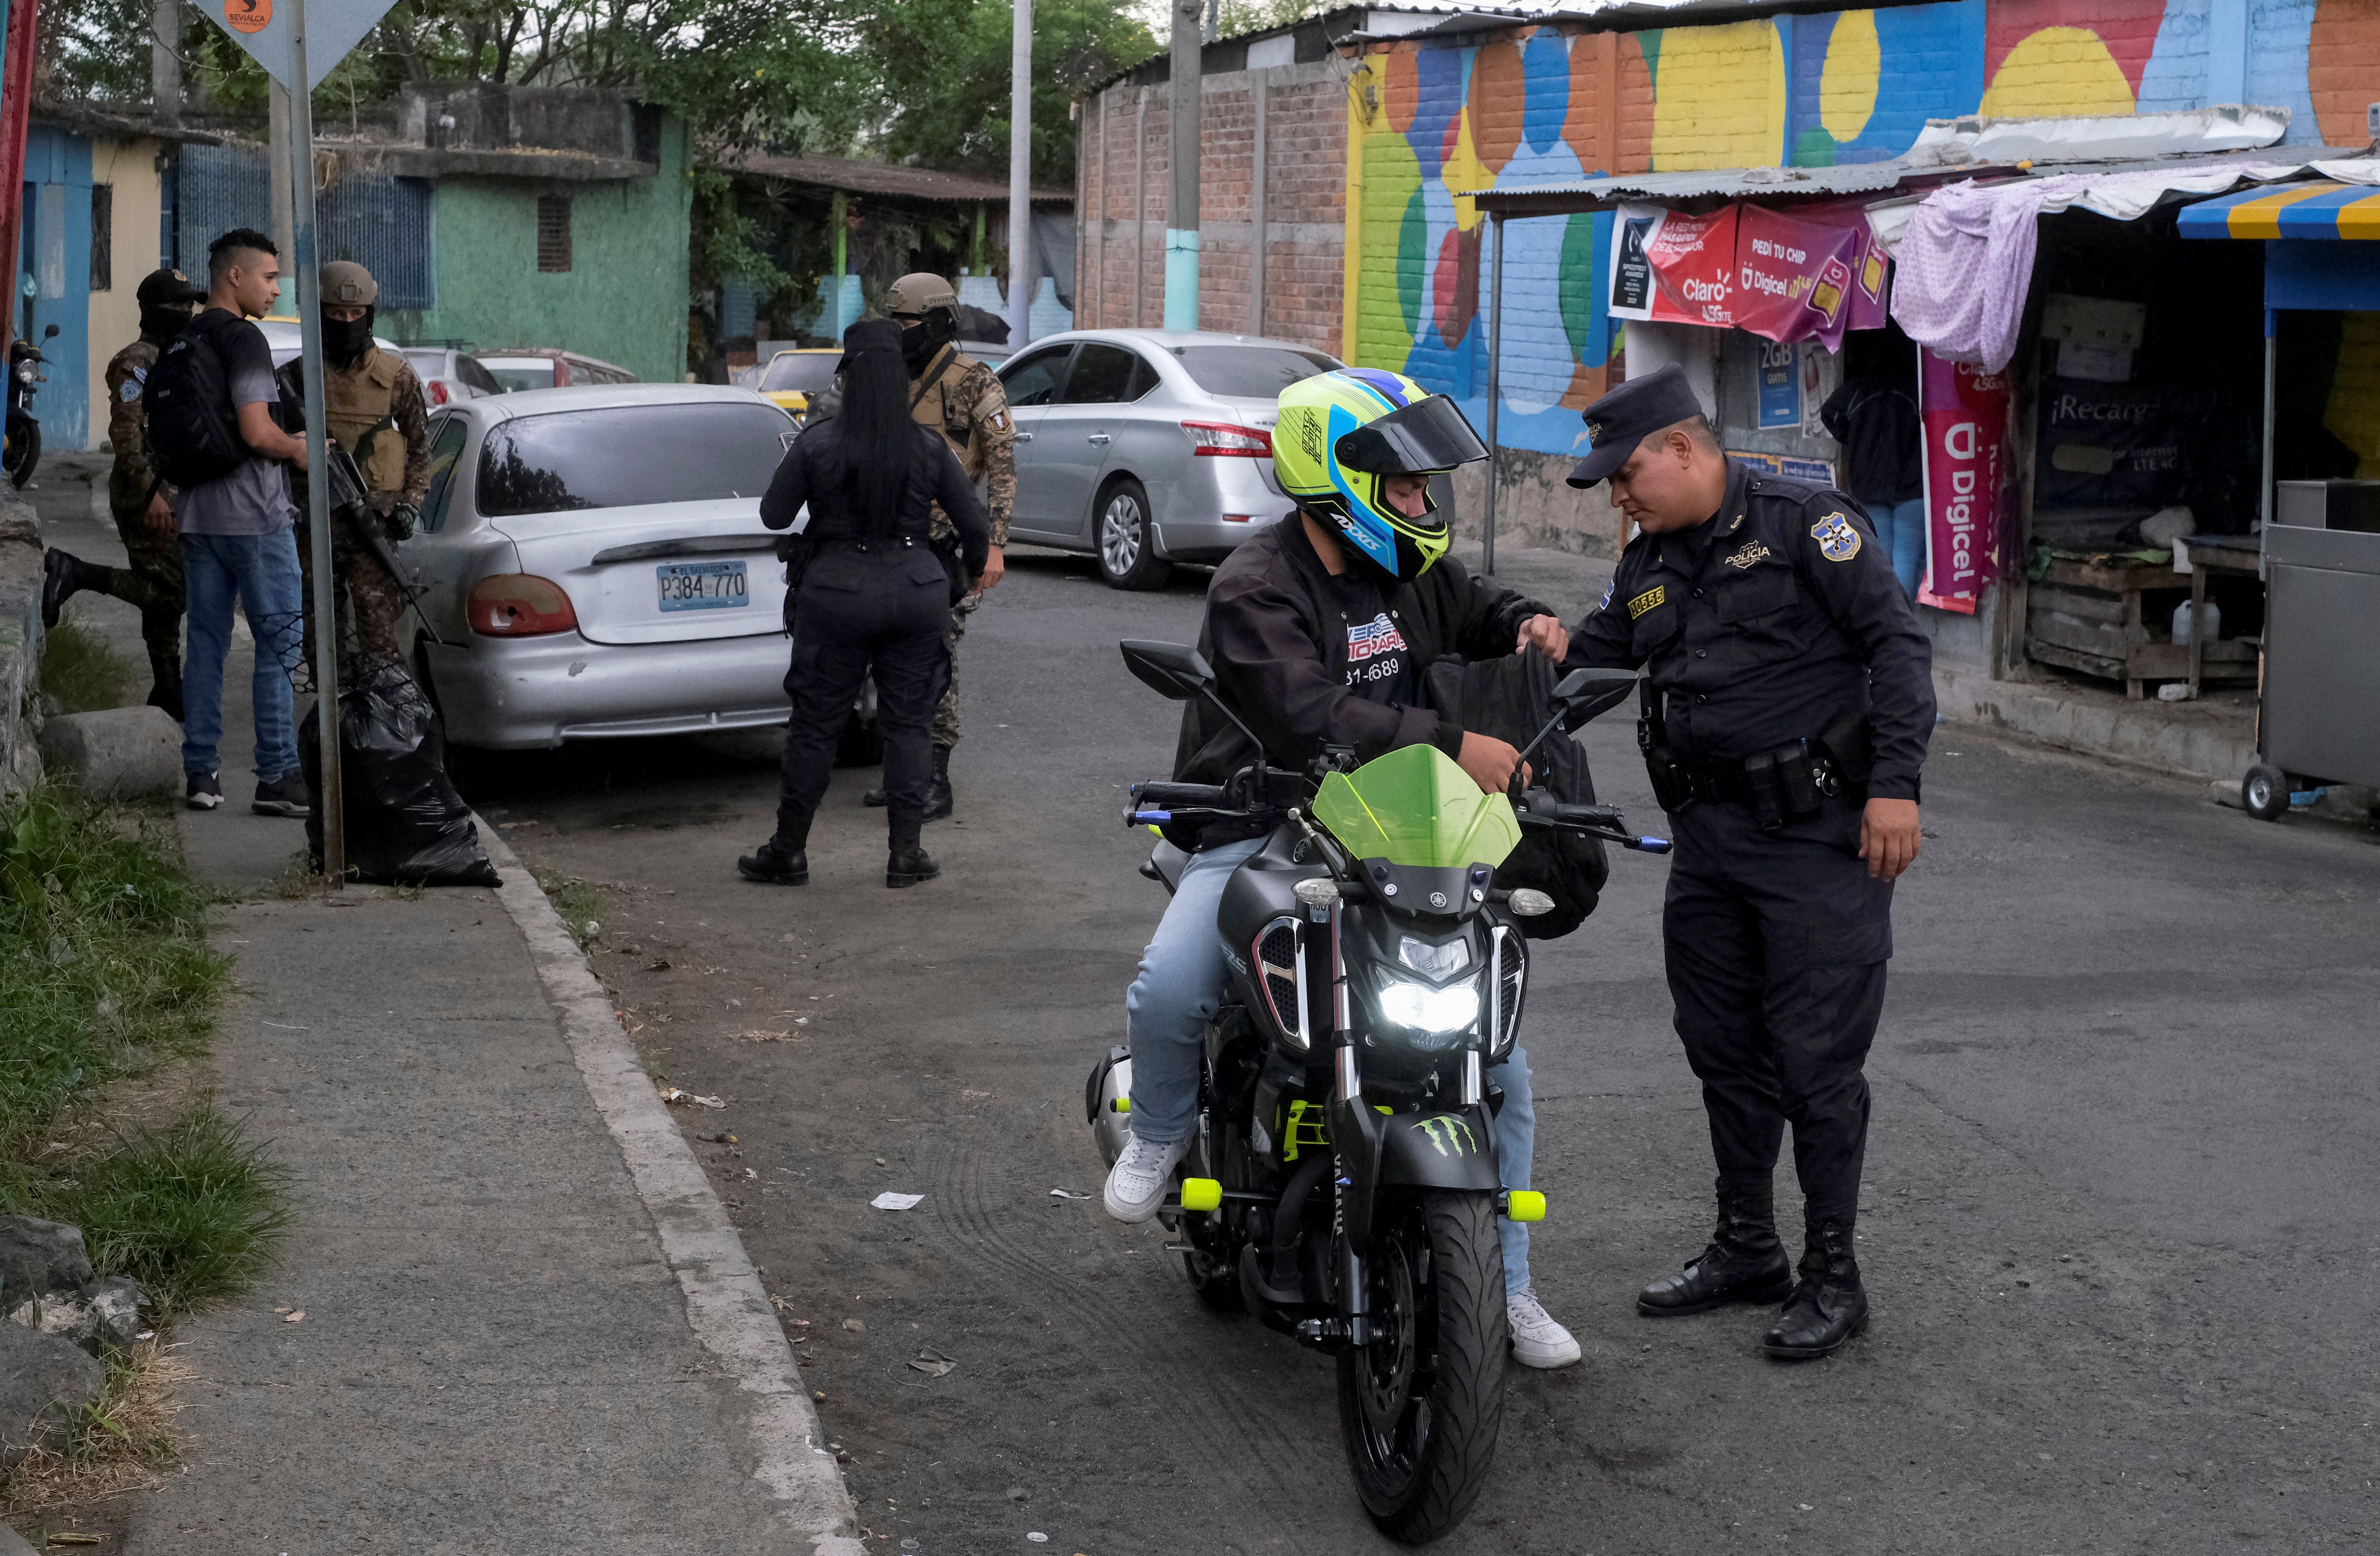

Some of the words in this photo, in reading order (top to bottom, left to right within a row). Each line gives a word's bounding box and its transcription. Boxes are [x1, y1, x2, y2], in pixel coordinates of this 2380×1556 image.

[229, 14, 265, 22] SEVIALCA
[1774, 244, 1785, 260] TU
[1786, 247, 1806, 265] CHIP
[1682, 278, 1725, 302] Claro
[1754, 271, 1788, 296] Digicel
[1762, 341, 1793, 368] 2GB
[1329, 513, 1381, 550] AXXIS
[1947, 470, 1975, 582] Digicel
[690, 565, 724, 574] SALVADOR
[661, 575, 703, 601] P384
[713, 572, 745, 597] 770
